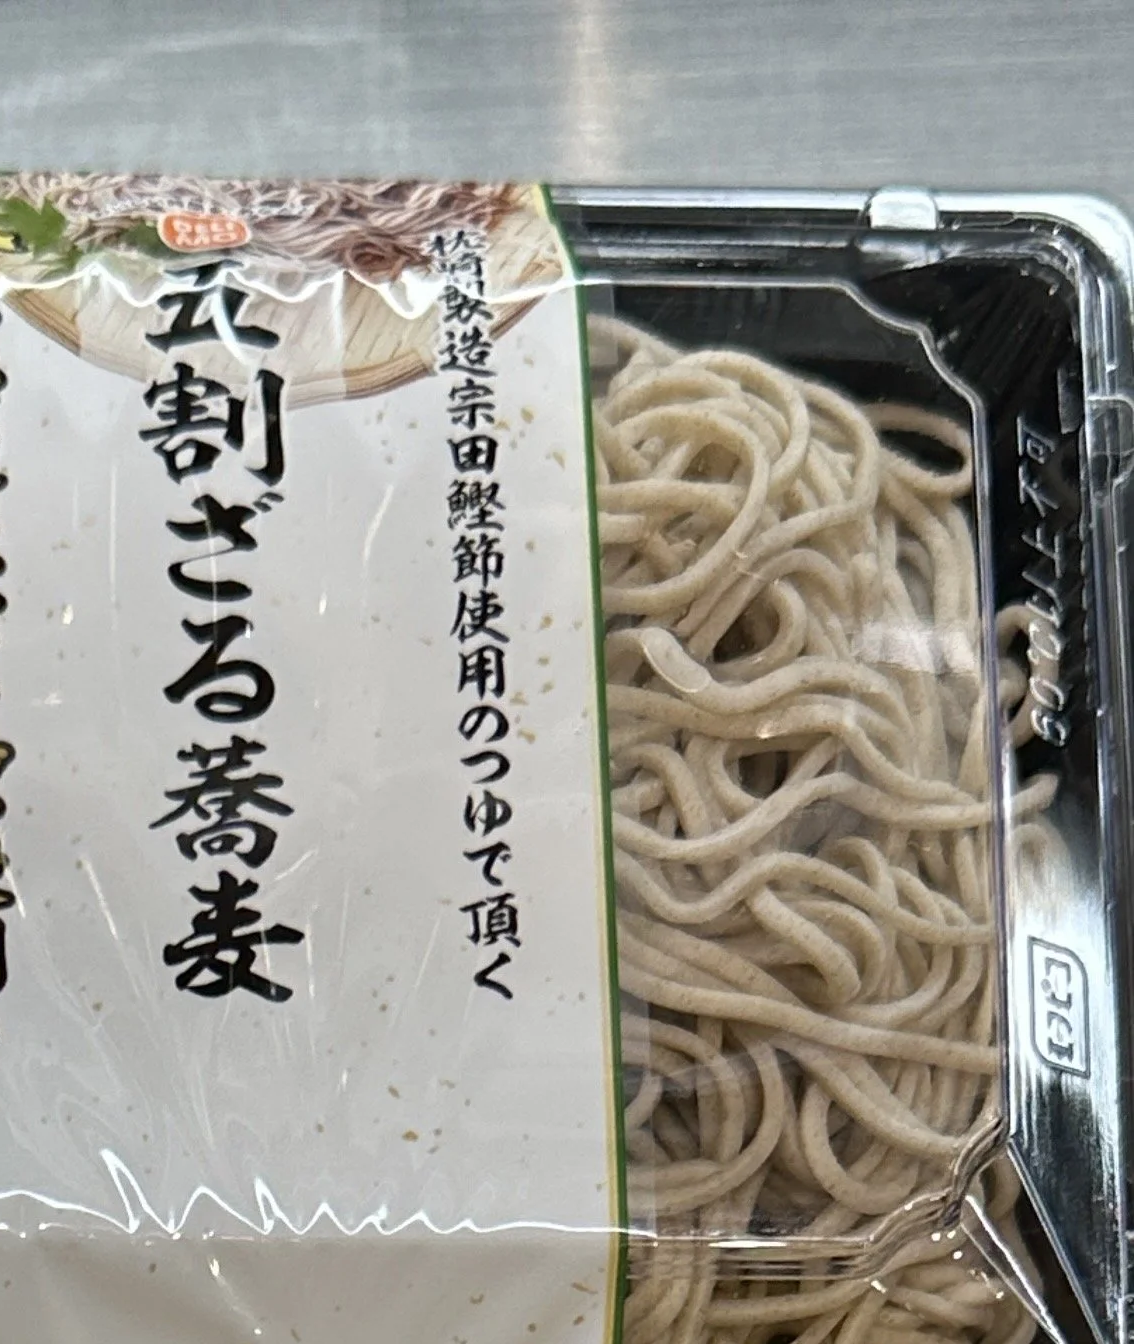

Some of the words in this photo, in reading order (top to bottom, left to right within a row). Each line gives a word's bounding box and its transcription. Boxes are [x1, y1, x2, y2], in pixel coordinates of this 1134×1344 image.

[139, 260, 303, 1002] 五割ざる蕎麦
